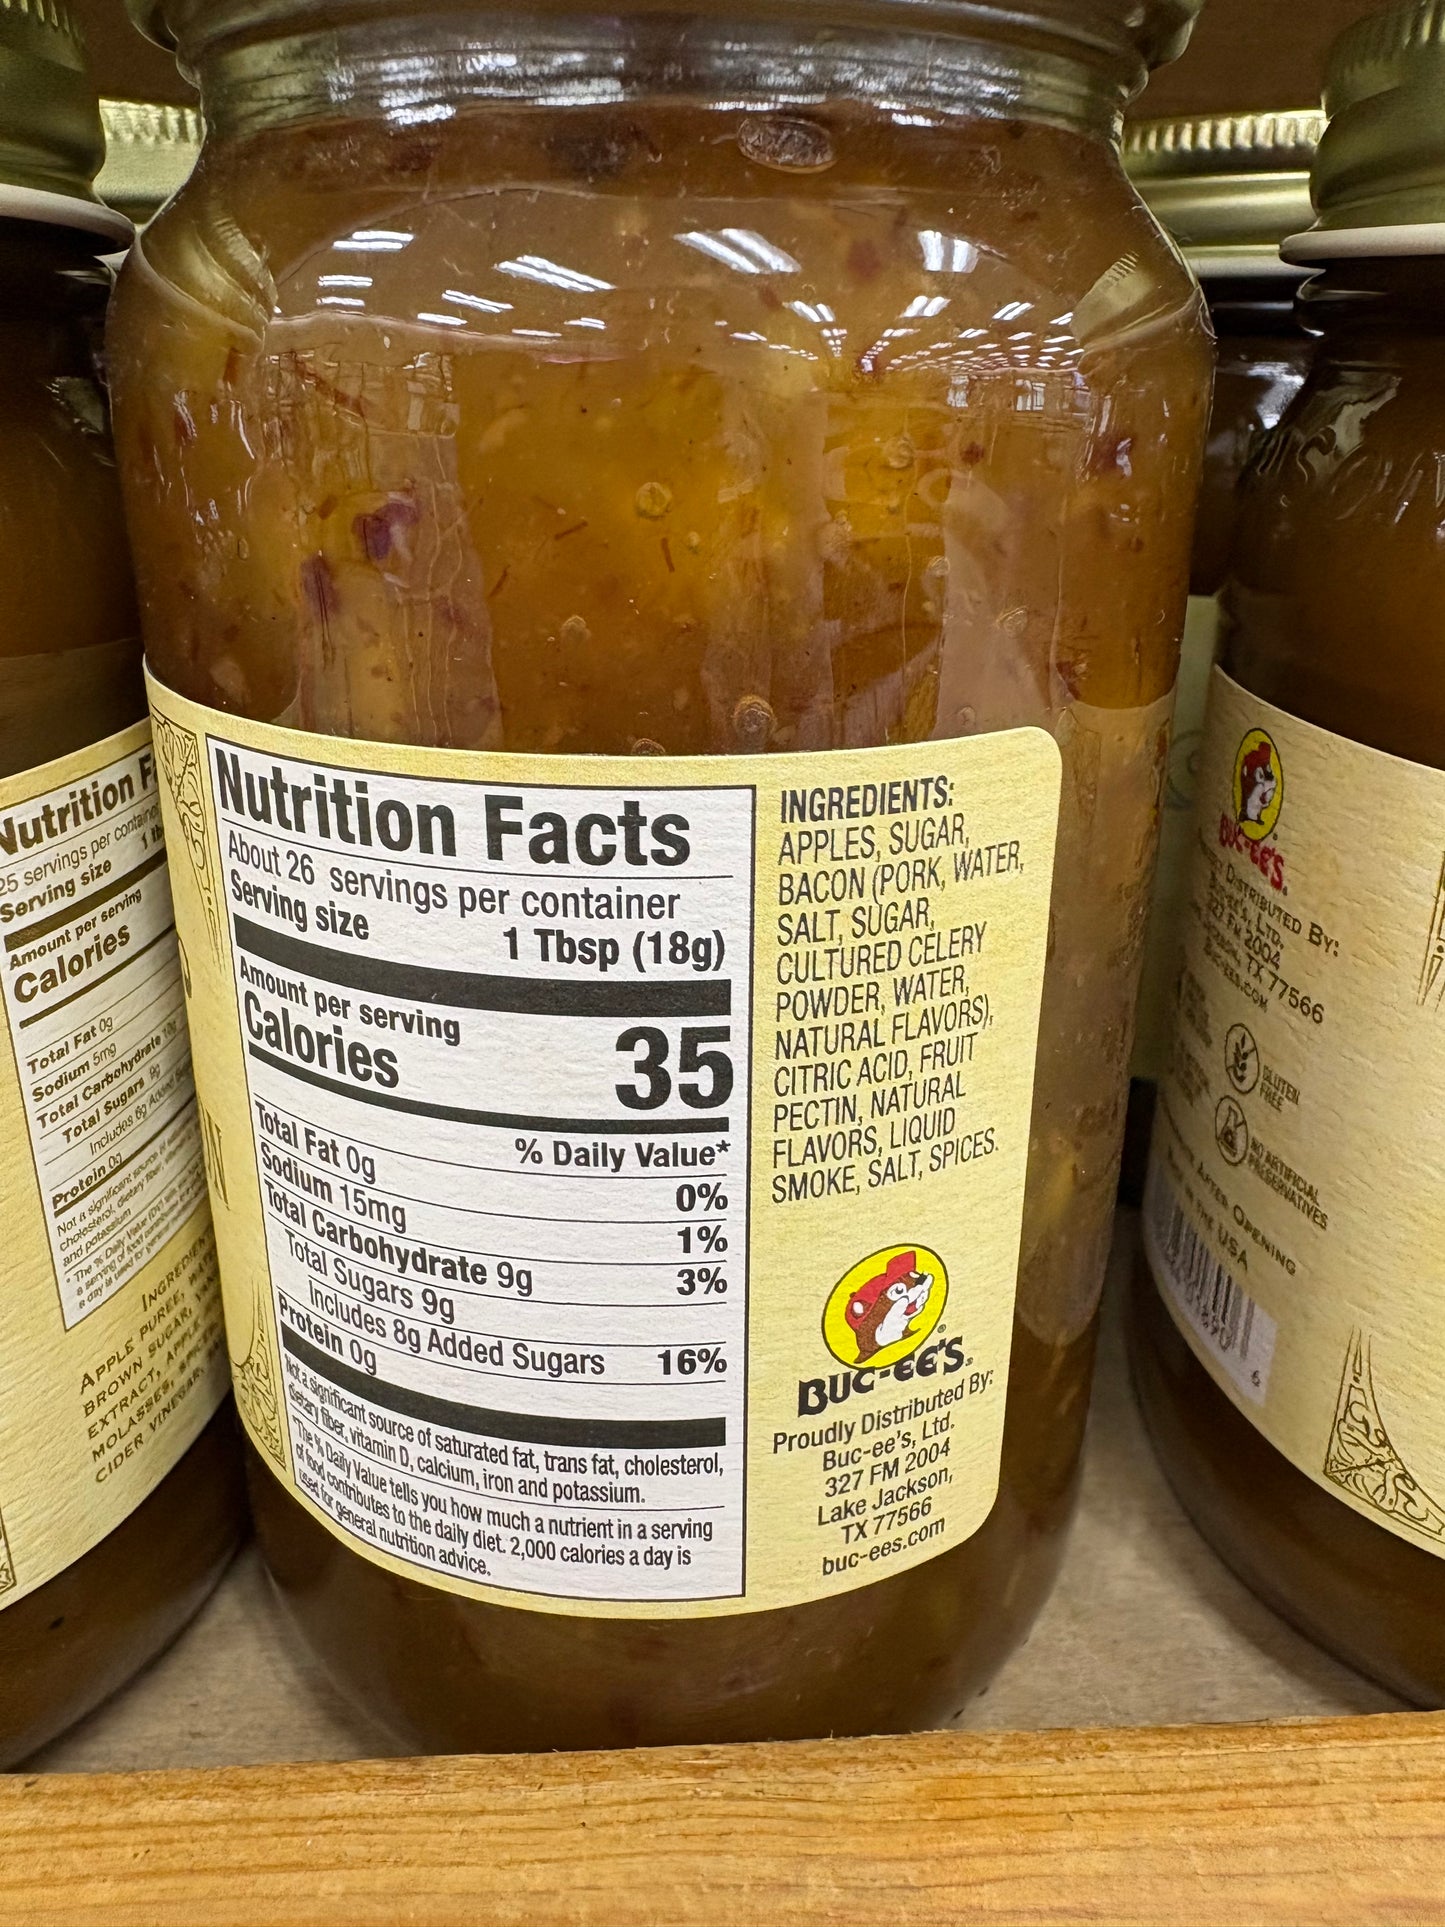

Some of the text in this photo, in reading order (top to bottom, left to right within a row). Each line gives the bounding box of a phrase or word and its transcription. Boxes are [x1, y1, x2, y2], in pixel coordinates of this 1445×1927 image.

[215, 748, 690, 867] Nutrition Facts
[781, 775, 955, 823] INGREDIENTS:
[24, 834, 111, 886] servings per
[777, 812, 969, 866] APPLES, SUGAR,
[0, 860, 112, 923] Serving size
[228, 828, 680, 920] About 26 servings per container
[778, 840, 1024, 906] BACON (PORK, WATER,
[9, 887, 142, 971] Amount per serving
[230, 870, 726, 973] Serving size 1 Tbsp (18g)
[777, 896, 935, 947] SALT, SUGAR,
[777, 921, 987, 985] CULTURED CELERY
[14, 924, 130, 1004] Calories
[776, 965, 969, 1022] POWDER, WATER,
[1269, 967, 1325, 1025] 77566
[240, 954, 460, 1046] Amount per serving
[775, 993, 993, 1060] NATURAL FLAVORS),
[27, 1016, 113, 1075] Total Fat 0g
[244, 991, 400, 1089] Calories
[615, 1026, 734, 1111] 35
[774, 1032, 978, 1097] CITRIC ACID, FRUIT
[32, 1062, 90, 1103] Sodium
[37, 1096, 79, 1129] Total
[82, 1036, 162, 1102] Carbohydrate
[62, 1111, 101, 1144] Total
[103, 1077, 145, 1114] Sugars
[773, 1071, 966, 1132] PECTIN, NATURAL
[255, 1100, 728, 1212] Total Fat 0g 0%
[514, 1138, 543, 1164] %
[553, 1140, 625, 1173] Daily
[772, 1127, 999, 1204] SMOKE, SALT, SPICES.
[773, 1107, 955, 1168] FLAVORS, LIQUID
[53, 1165, 106, 1209] Protein
[260, 1141, 333, 1204] Sodium
[340, 1183, 406, 1234] 15mg
[677, 1224, 728, 1254] 1%
[264, 1179, 728, 1297] Total Carbohydrate 9g 3%
[285, 1228, 455, 1324] Total Sugars 9g
[278, 1290, 343, 1356] Protein
[350, 1339, 377, 1376] 0g
[308, 1279, 728, 1378] Includes 8g Added Sugars 16%
[83, 1356, 143, 1418] BROWN
[88, 1367, 161, 1440] EXTRACT,
[773, 1369, 993, 1454] Proudly Distributed By:
[95, 1433, 145, 1483] CIDER
[309, 1375, 367, 1424] significant
[369, 1411, 414, 1442] source
[417, 1427, 432, 1448] of
[435, 1434, 508, 1467] saturated
[512, 1446, 540, 1473] fat,
[544, 1451, 587, 1475] trans
[592, 1453, 619, 1479] fat,
[624, 1452, 724, 1477] cholesterol,
[823, 1411, 955, 1472] Buc-ee's, Ltd.
[325, 1441, 713, 1542] Daily Value tells you how much a nutrient in a serving
[349, 1424, 645, 1503] vitamin D, calcium, iron and potassium.
[818, 1467, 953, 1526] Lake Jackson,
[824, 1437, 951, 1498] 327 FM 2004
[327, 1469, 390, 1519] contributes
[392, 1505, 406, 1526] to
[408, 1510, 431, 1535] the
[435, 1519, 468, 1549] daily
[473, 1531, 506, 1554] diet.
[510, 1536, 556, 1561] 2,000
[560, 1543, 624, 1566] calories
[629, 1549, 640, 1565] a
[643, 1545, 673, 1570] day
[677, 1545, 692, 1565] is
[336, 1499, 491, 1576] general nutrition advice.
[822, 1517, 945, 1576] buc-ees.com
[841, 1496, 932, 1544] TX 77566
